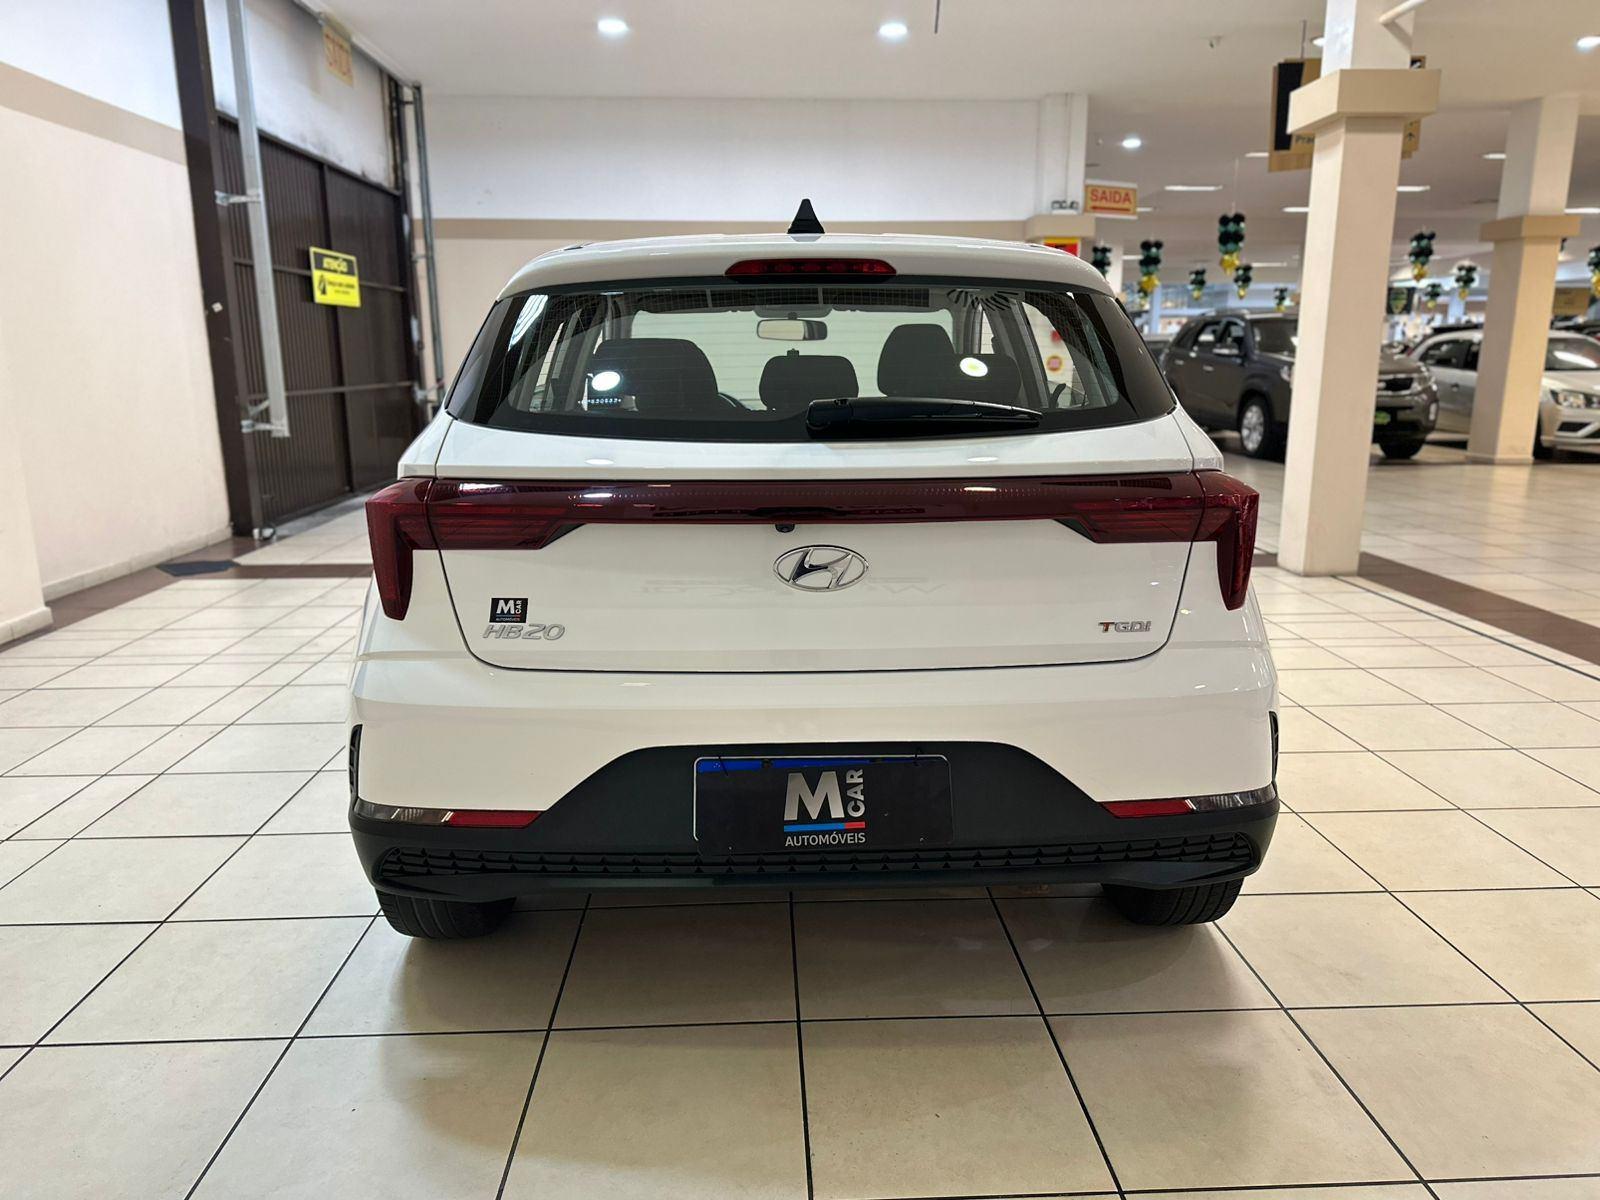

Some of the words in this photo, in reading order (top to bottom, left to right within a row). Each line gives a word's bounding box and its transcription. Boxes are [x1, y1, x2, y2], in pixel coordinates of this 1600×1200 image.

[1090, 188, 1132, 204] SAIDA
[496, 599, 514, 614] M
[482, 623, 565, 641] HB20
[783, 771, 845, 821] M
[846, 769, 866, 818] CAR
[785, 831, 866, 847] AUTOMÓVEIS
